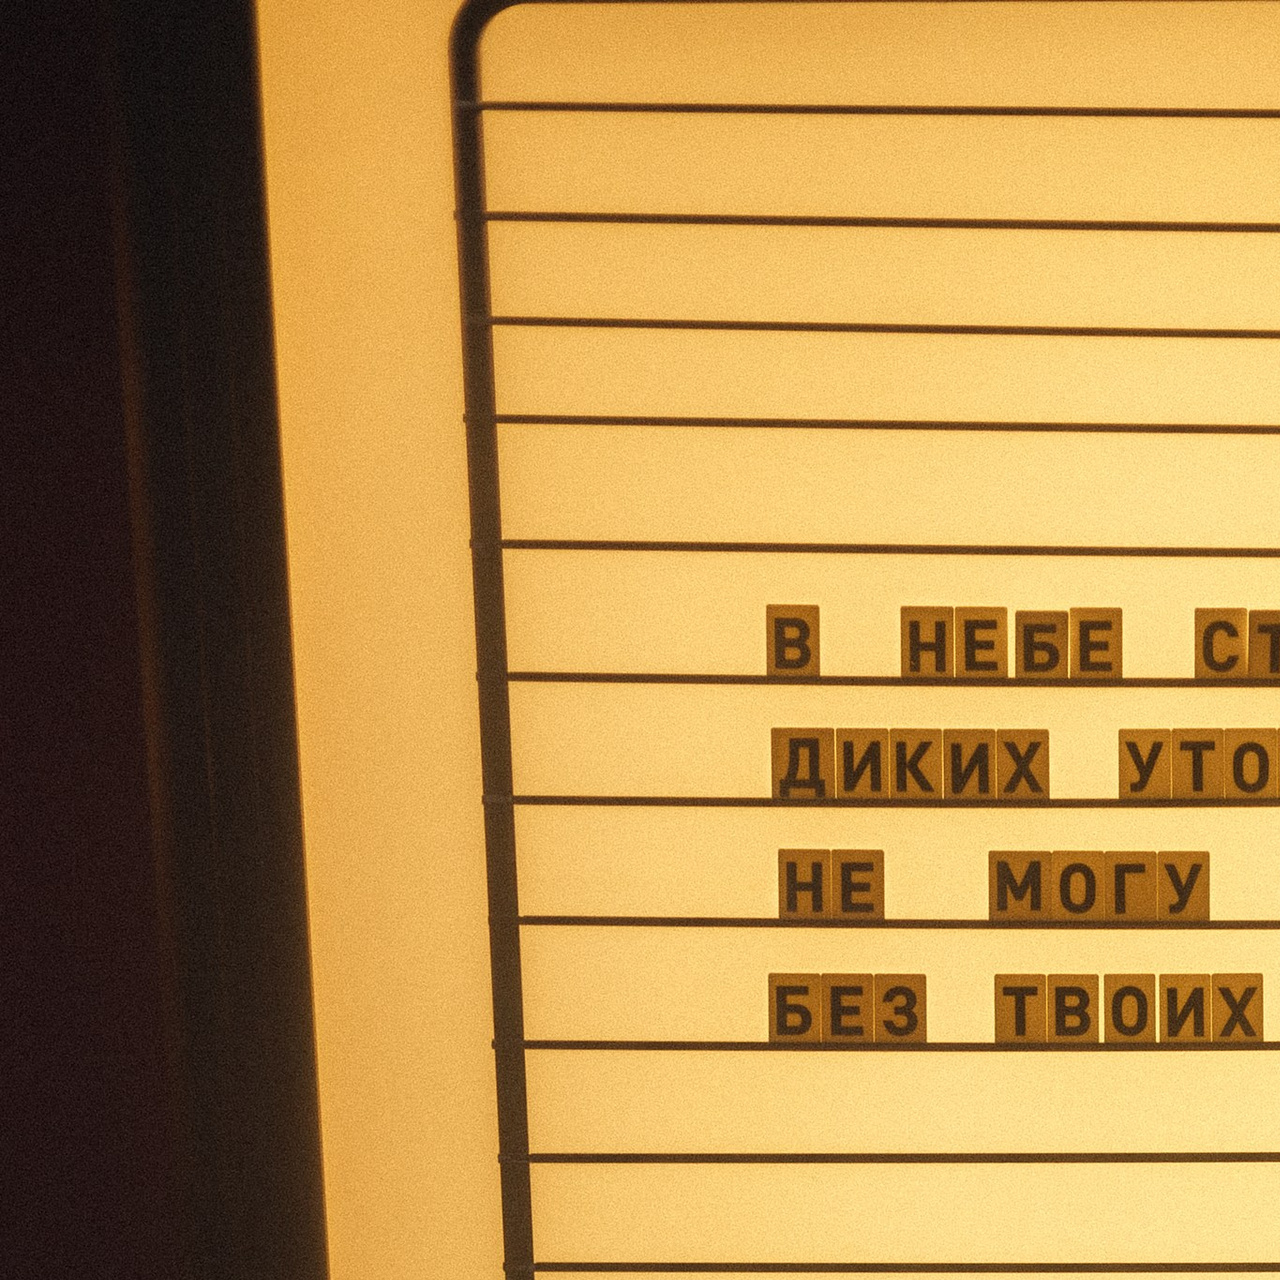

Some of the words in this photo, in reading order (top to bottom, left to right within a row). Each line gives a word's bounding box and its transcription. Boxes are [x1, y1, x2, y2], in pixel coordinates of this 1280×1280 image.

[774, 617, 812, 671] В
[909, 619, 1114, 672] НЕБЕ
[778, 737, 1045, 797] ДИКИХ
[786, 860, 876, 914] НЕ
[998, 860, 1203, 914] МОГУ
[775, 984, 920, 1039] БЕЗ
[1002, 985, 1258, 1038] ТВОИХ
